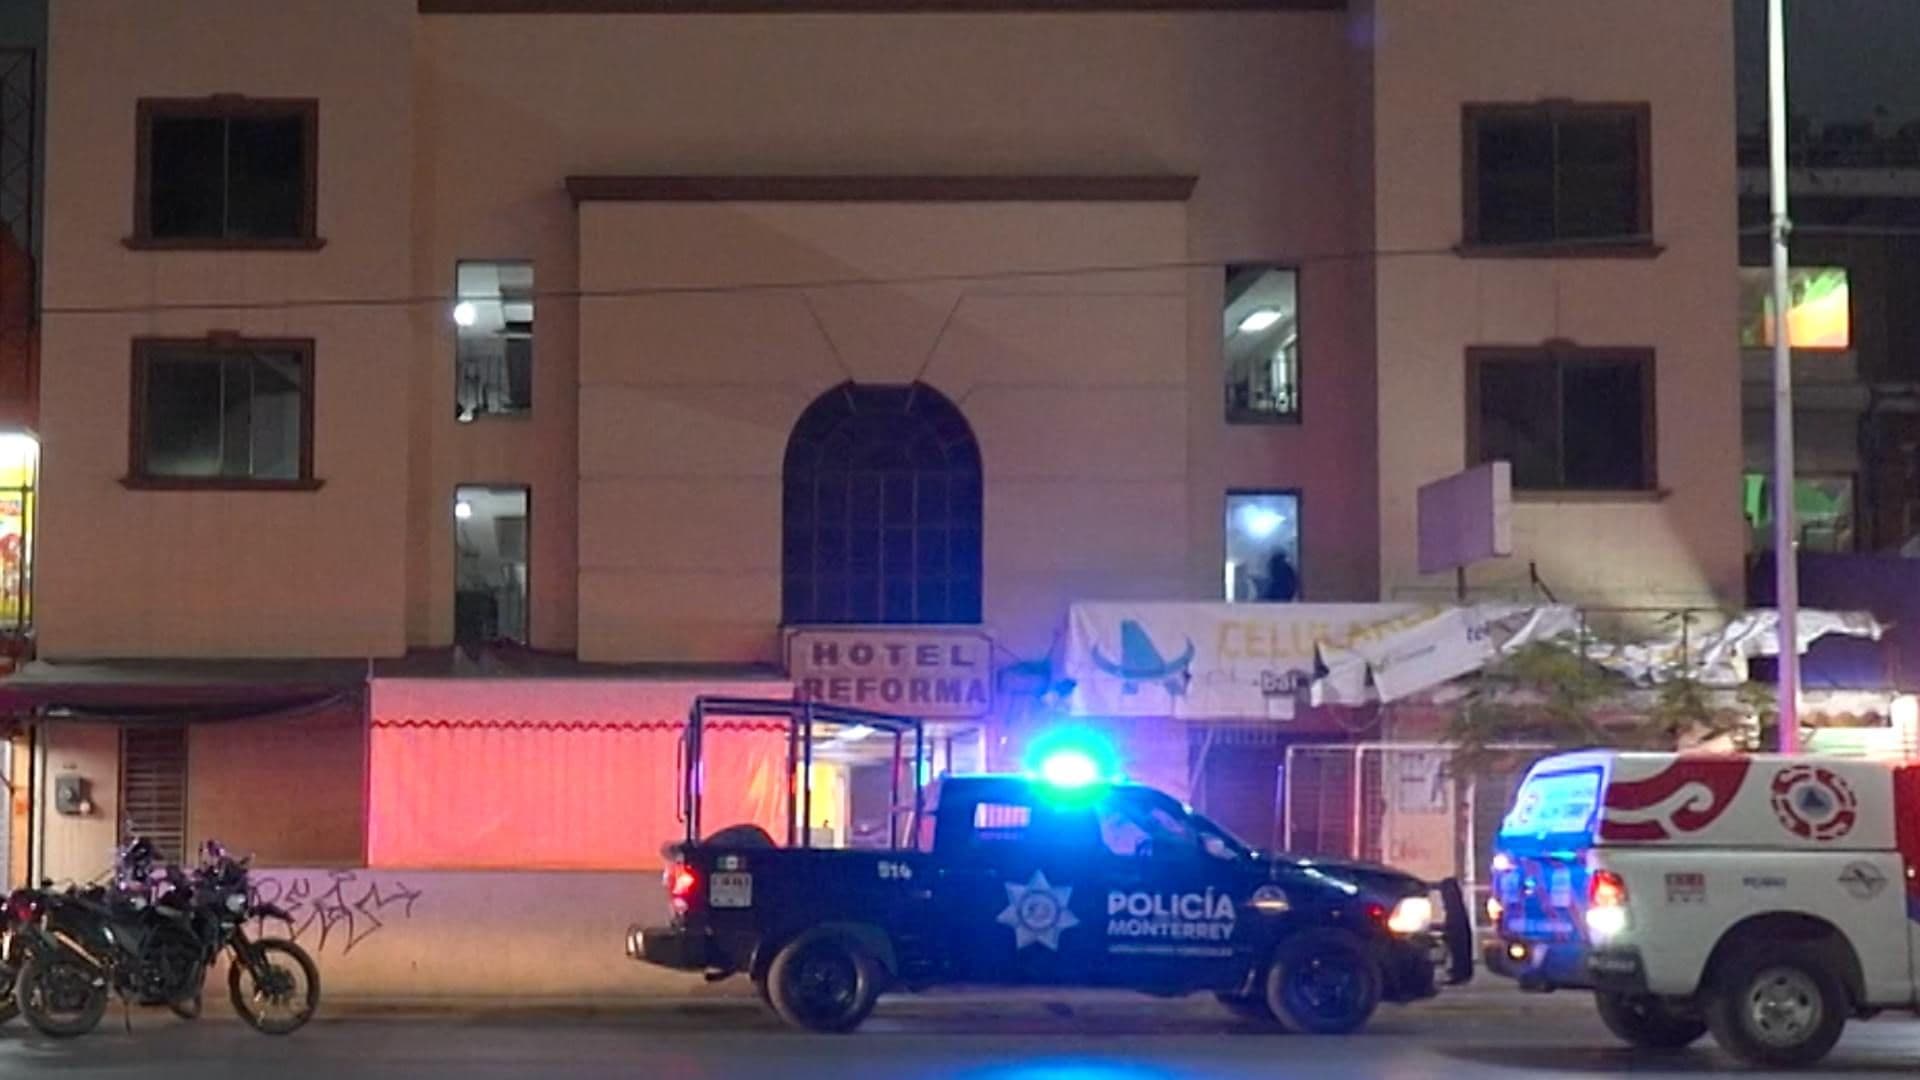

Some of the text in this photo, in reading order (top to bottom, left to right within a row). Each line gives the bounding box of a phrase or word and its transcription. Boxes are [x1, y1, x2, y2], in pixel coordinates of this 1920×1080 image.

[812, 642, 975, 666] HOTEL
[803, 677, 987, 703] REFORMA
[1107, 886, 1236, 920] POLICÍA
[1107, 919, 1236, 941] MONTERREY
